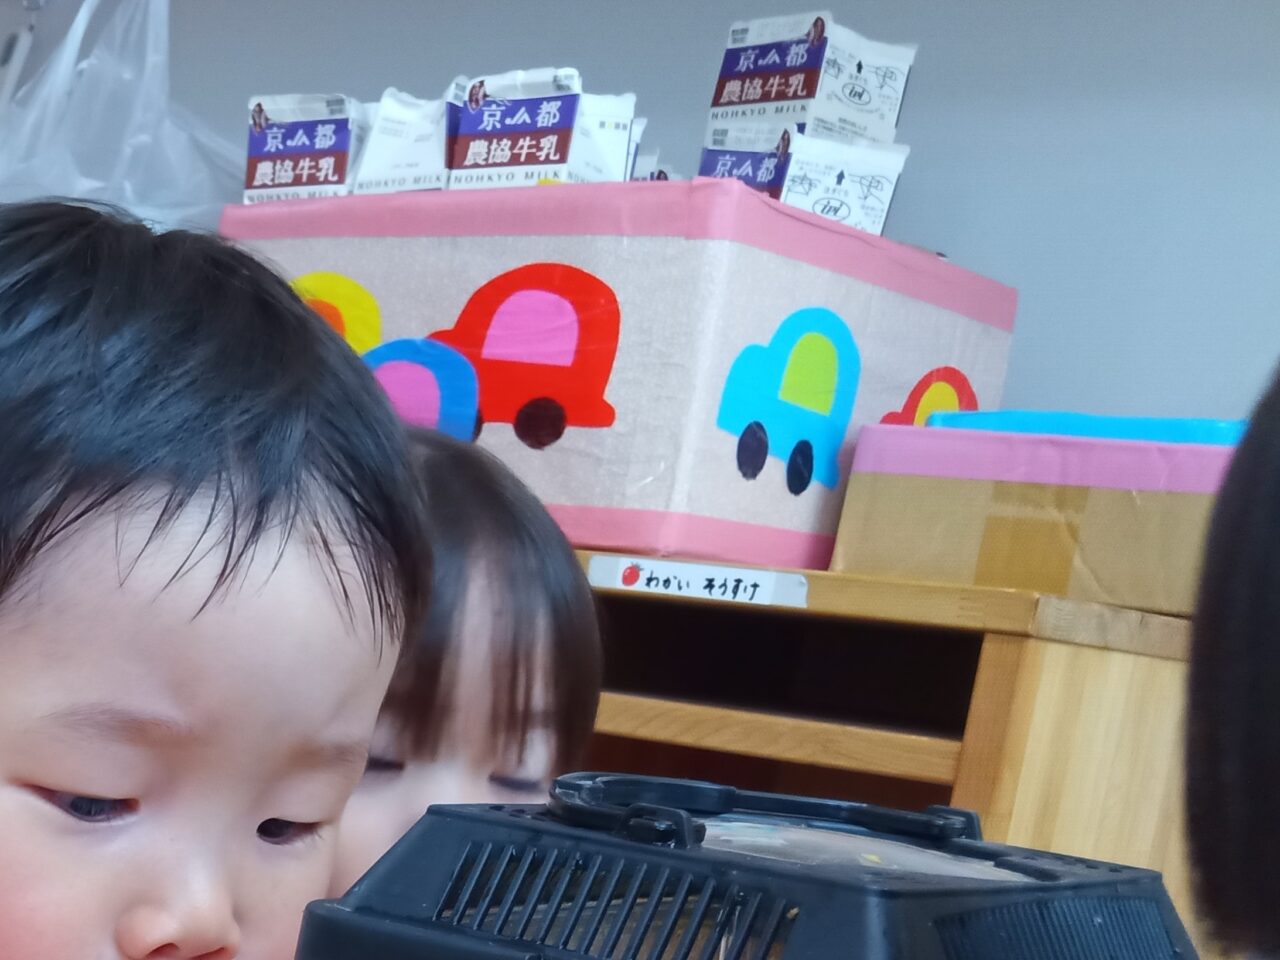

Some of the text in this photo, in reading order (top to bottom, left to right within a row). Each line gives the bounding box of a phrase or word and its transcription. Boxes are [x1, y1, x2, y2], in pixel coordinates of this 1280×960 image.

[719, 73, 807, 104] 農協牛乳
[711, 104, 807, 120] NOHKYO MILK
[463, 134, 561, 167] 農協牛乳
[252, 156, 339, 187] 農協牛乳
[454, 171, 515, 184] NOHKYO
